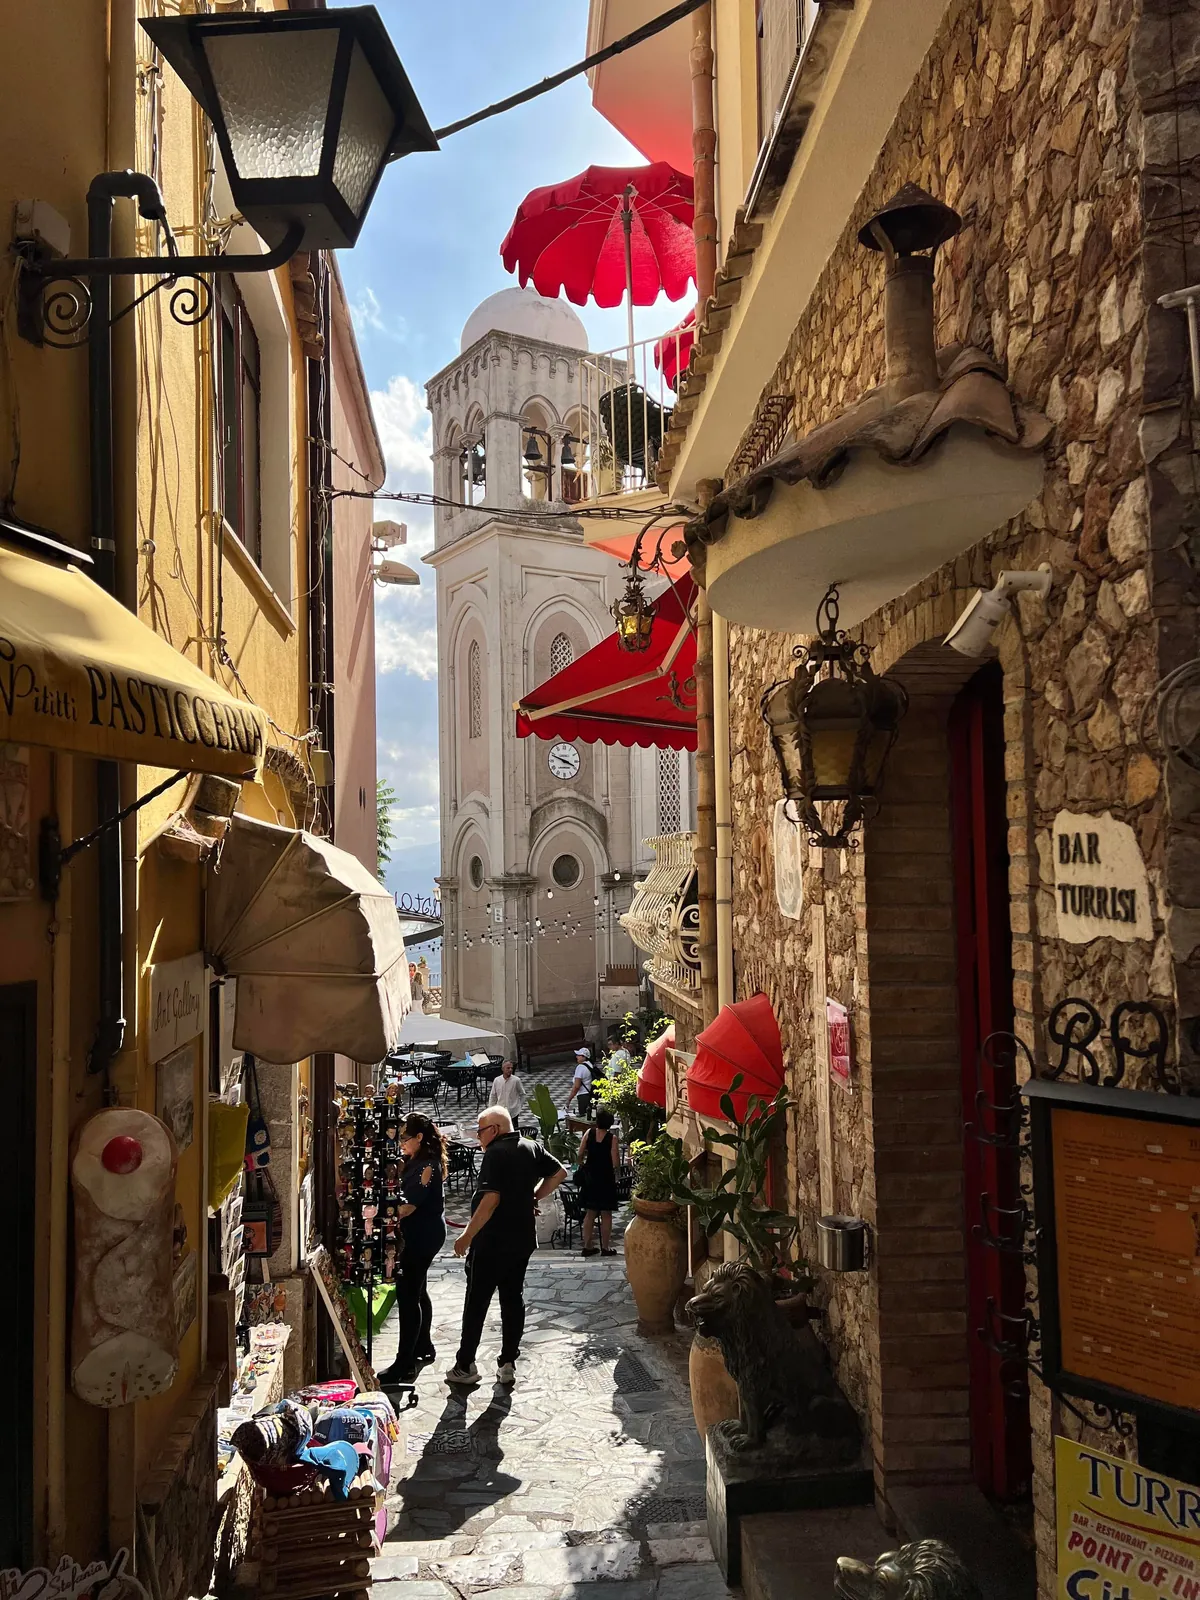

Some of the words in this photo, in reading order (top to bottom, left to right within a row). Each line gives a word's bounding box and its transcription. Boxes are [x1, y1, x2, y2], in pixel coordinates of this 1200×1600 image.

[83, 664, 263, 757] PASTICCERIA
[1058, 832, 1101, 864] BAR
[1058, 883, 1136, 923] TURRISI
[1079, 1453, 1200, 1529] TURR
[1068, 1531, 1134, 1574] POINT
[1138, 1560, 1168, 1588] OF
[1073, 1513, 1089, 1527] BAR
[1096, 1522, 1148, 1550] RESTAURANT
[1155, 1546, 1195, 1571] PIZZERIA
[48, 1564, 104, 1595] Stefania
